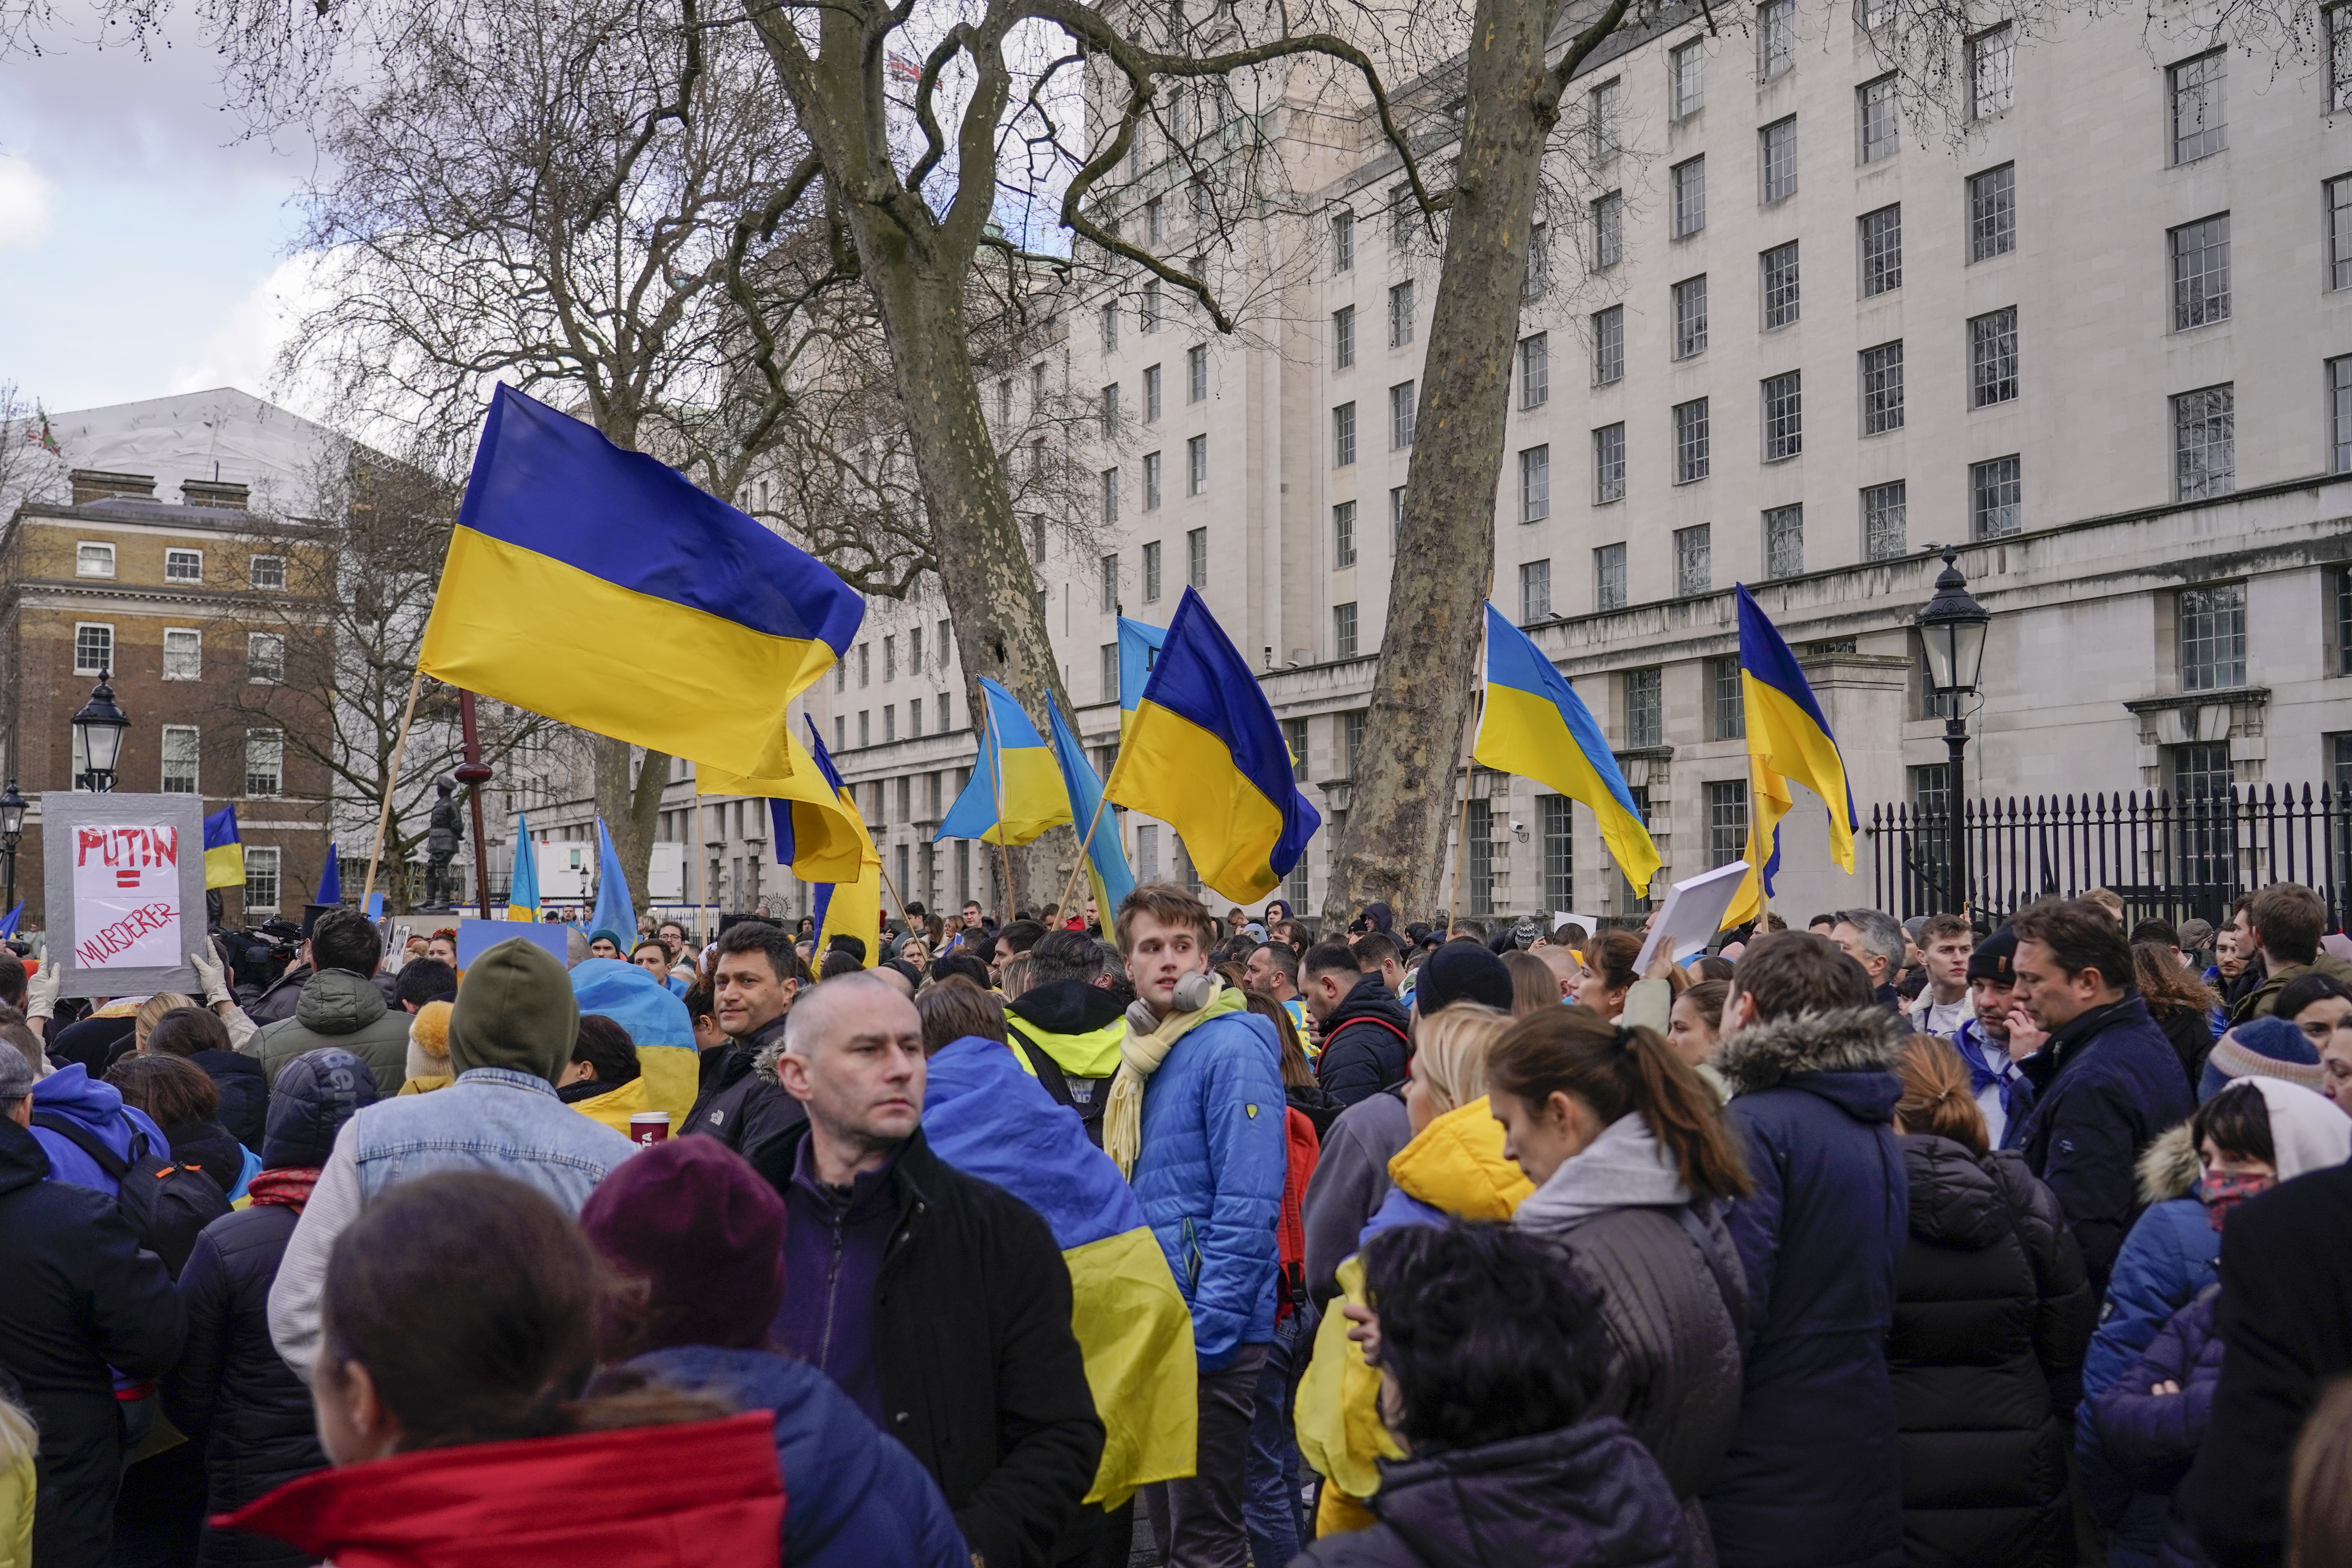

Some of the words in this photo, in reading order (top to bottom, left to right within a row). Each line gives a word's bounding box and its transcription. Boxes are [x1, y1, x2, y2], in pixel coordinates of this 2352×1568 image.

[78, 826, 178, 868] PUTIN
[76, 903, 180, 968] MURDERER
[392, 929, 406, 956] STOP
